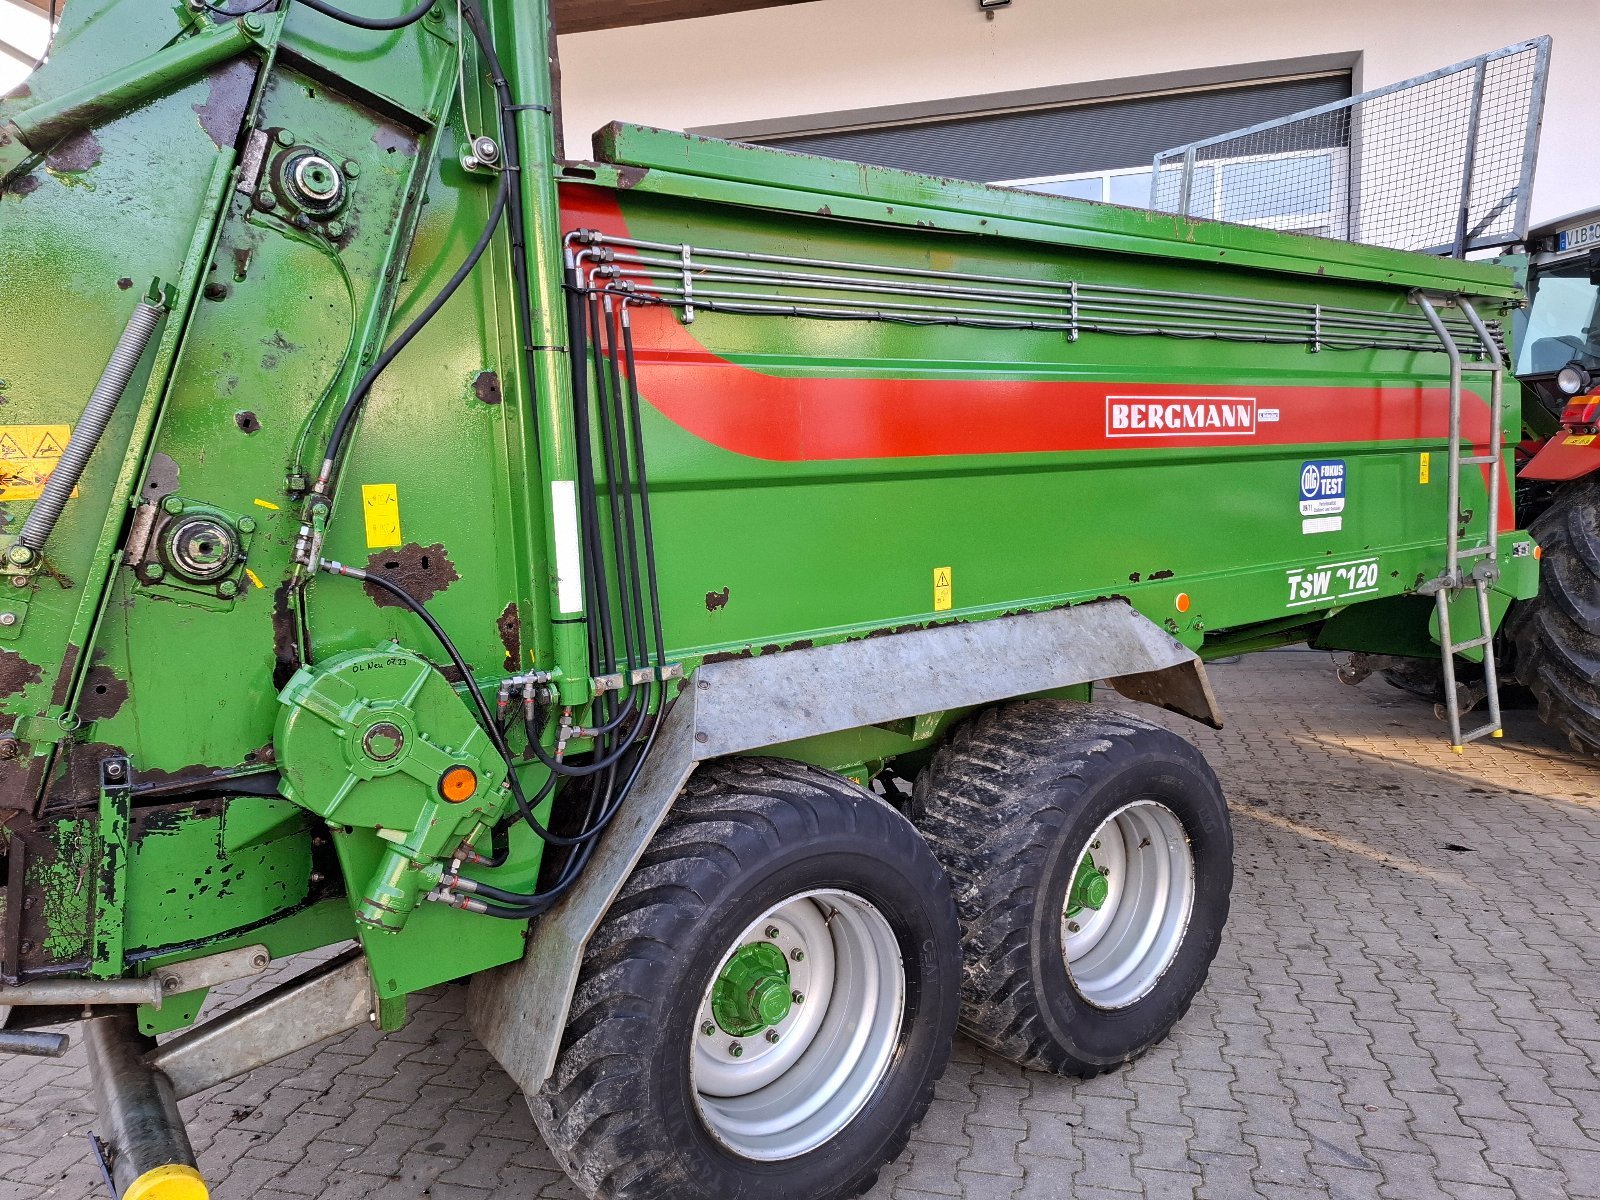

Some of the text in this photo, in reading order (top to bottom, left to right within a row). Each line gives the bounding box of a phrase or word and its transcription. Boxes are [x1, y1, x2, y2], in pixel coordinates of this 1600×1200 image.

[1567, 228, 1587, 246] VIB
[1112, 404, 1250, 430] BERGMANN
[1321, 465, 1344, 476] FOKUS
[1321, 478, 1343, 495] TEST
[1288, 570, 1332, 601] TSW
